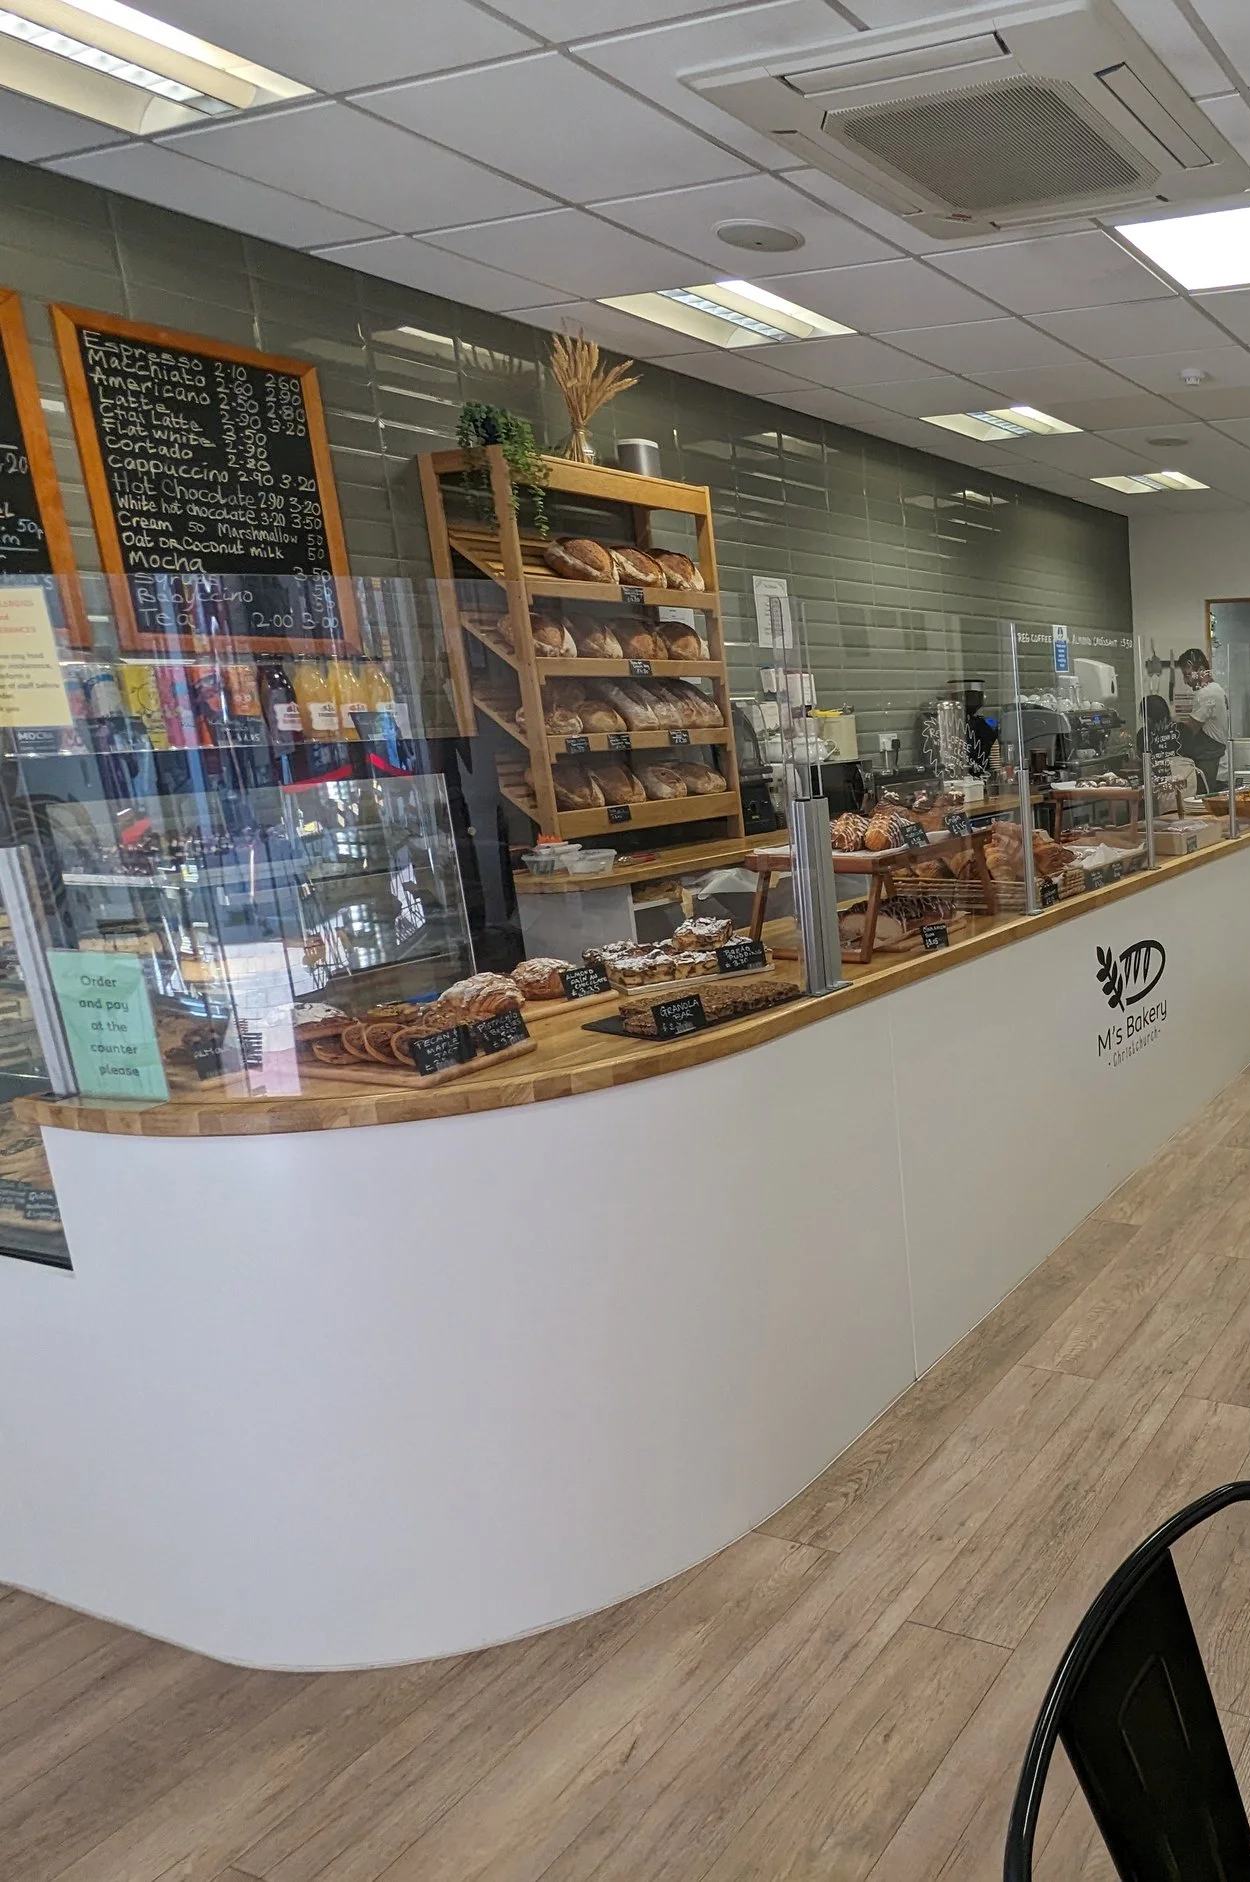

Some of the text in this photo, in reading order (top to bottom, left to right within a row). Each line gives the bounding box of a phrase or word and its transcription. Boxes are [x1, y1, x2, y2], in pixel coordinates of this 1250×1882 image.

[83, 330, 203, 371] Espresso
[214, 362, 247, 380] 2.10
[88, 349, 206, 387] Macchiato
[89, 366, 211, 405] Americano
[99, 386, 170, 413] Latte
[100, 403, 145, 424] Chai
[152, 411, 203, 431] Latte
[112, 471, 158, 496] Hot
[161, 478, 257, 508] Chocolate
[116, 492, 158, 512] White
[161, 498, 183, 515] hot
[118, 511, 173, 531] Cream
[122, 530, 154, 548] Oat
[129, 551, 207, 573] Mocha
[139, 608, 196, 629] Tea
[1031, 633, 1052, 643] COFFEE
[80, 975, 117, 988] Order
[566, 969, 594, 980] ALMOND
[79, 998, 129, 1013] and pay
[660, 999, 699, 1018] GRANOLA
[672, 1009, 694, 1021] BAR
[91, 1020, 128, 1032] at the
[1097, 1000, 1167, 1057] M's Bakery
[90, 1044, 138, 1055] counter
[414, 1033, 450, 1050] PECAN
[426, 1038, 460, 1055] MAPLE
[99, 1064, 140, 1077] please
